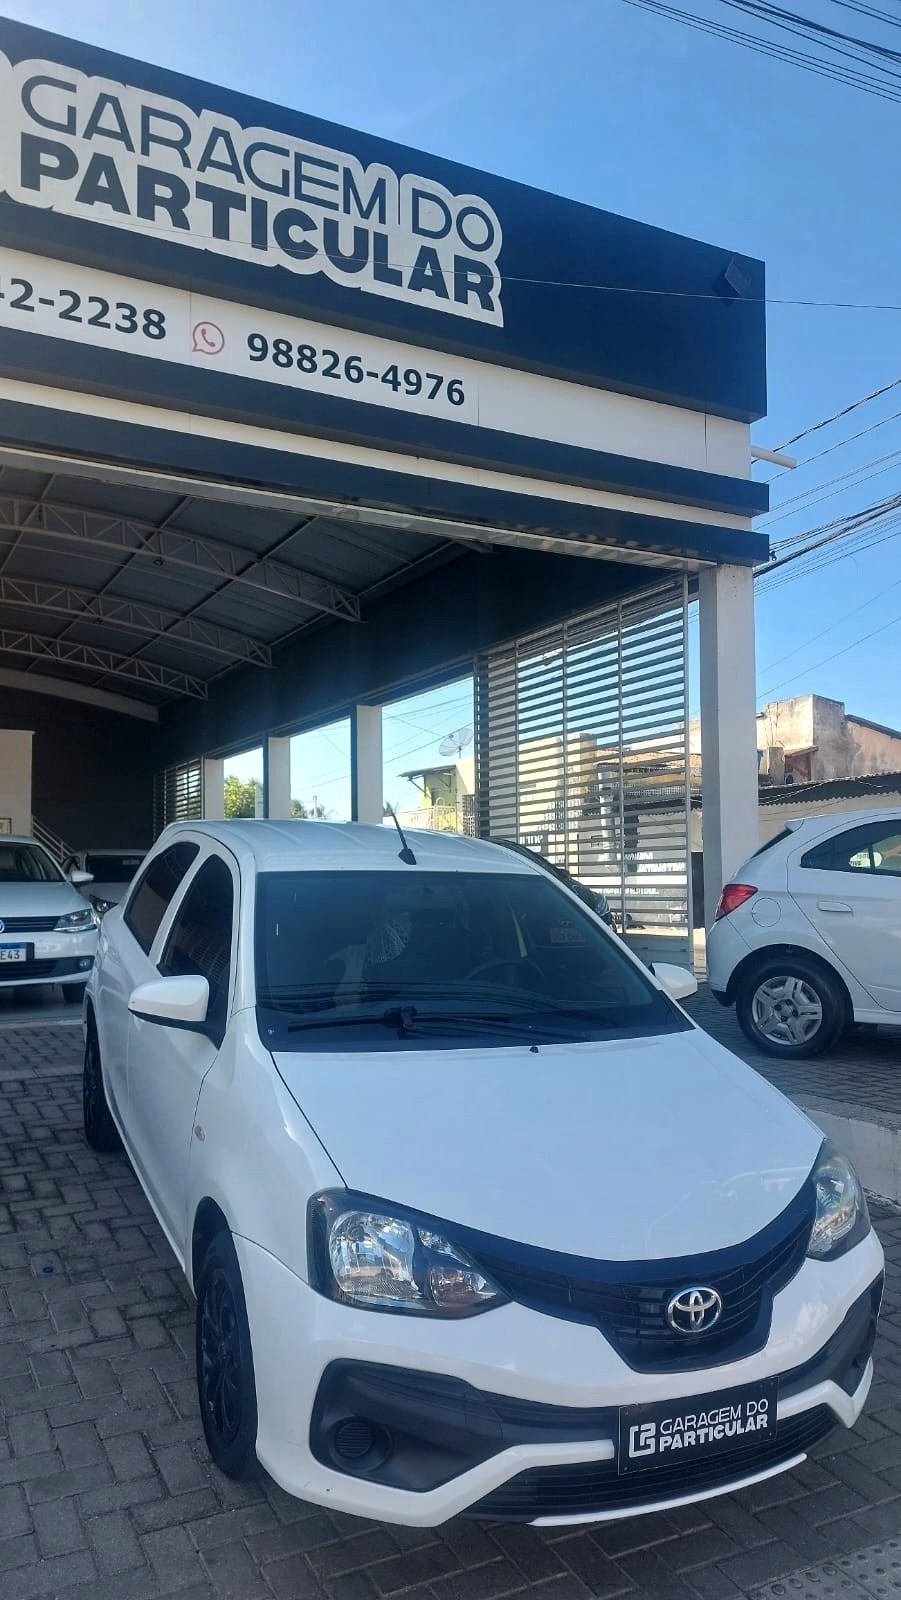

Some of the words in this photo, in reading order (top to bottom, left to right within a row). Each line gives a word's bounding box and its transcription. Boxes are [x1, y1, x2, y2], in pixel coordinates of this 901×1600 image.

[20, 74, 387, 225] GARAGEM
[411, 187, 496, 252] DO
[20, 132, 496, 313] PARTICULAR
[0, 278, 167, 340] 2-2238
[247, 333, 466, 406] 98826-4976
[659, 1414, 768, 1452] PARTICULAR
[660, 1404, 742, 1435] GARAGEM
[746, 1398, 769, 1416] DO
